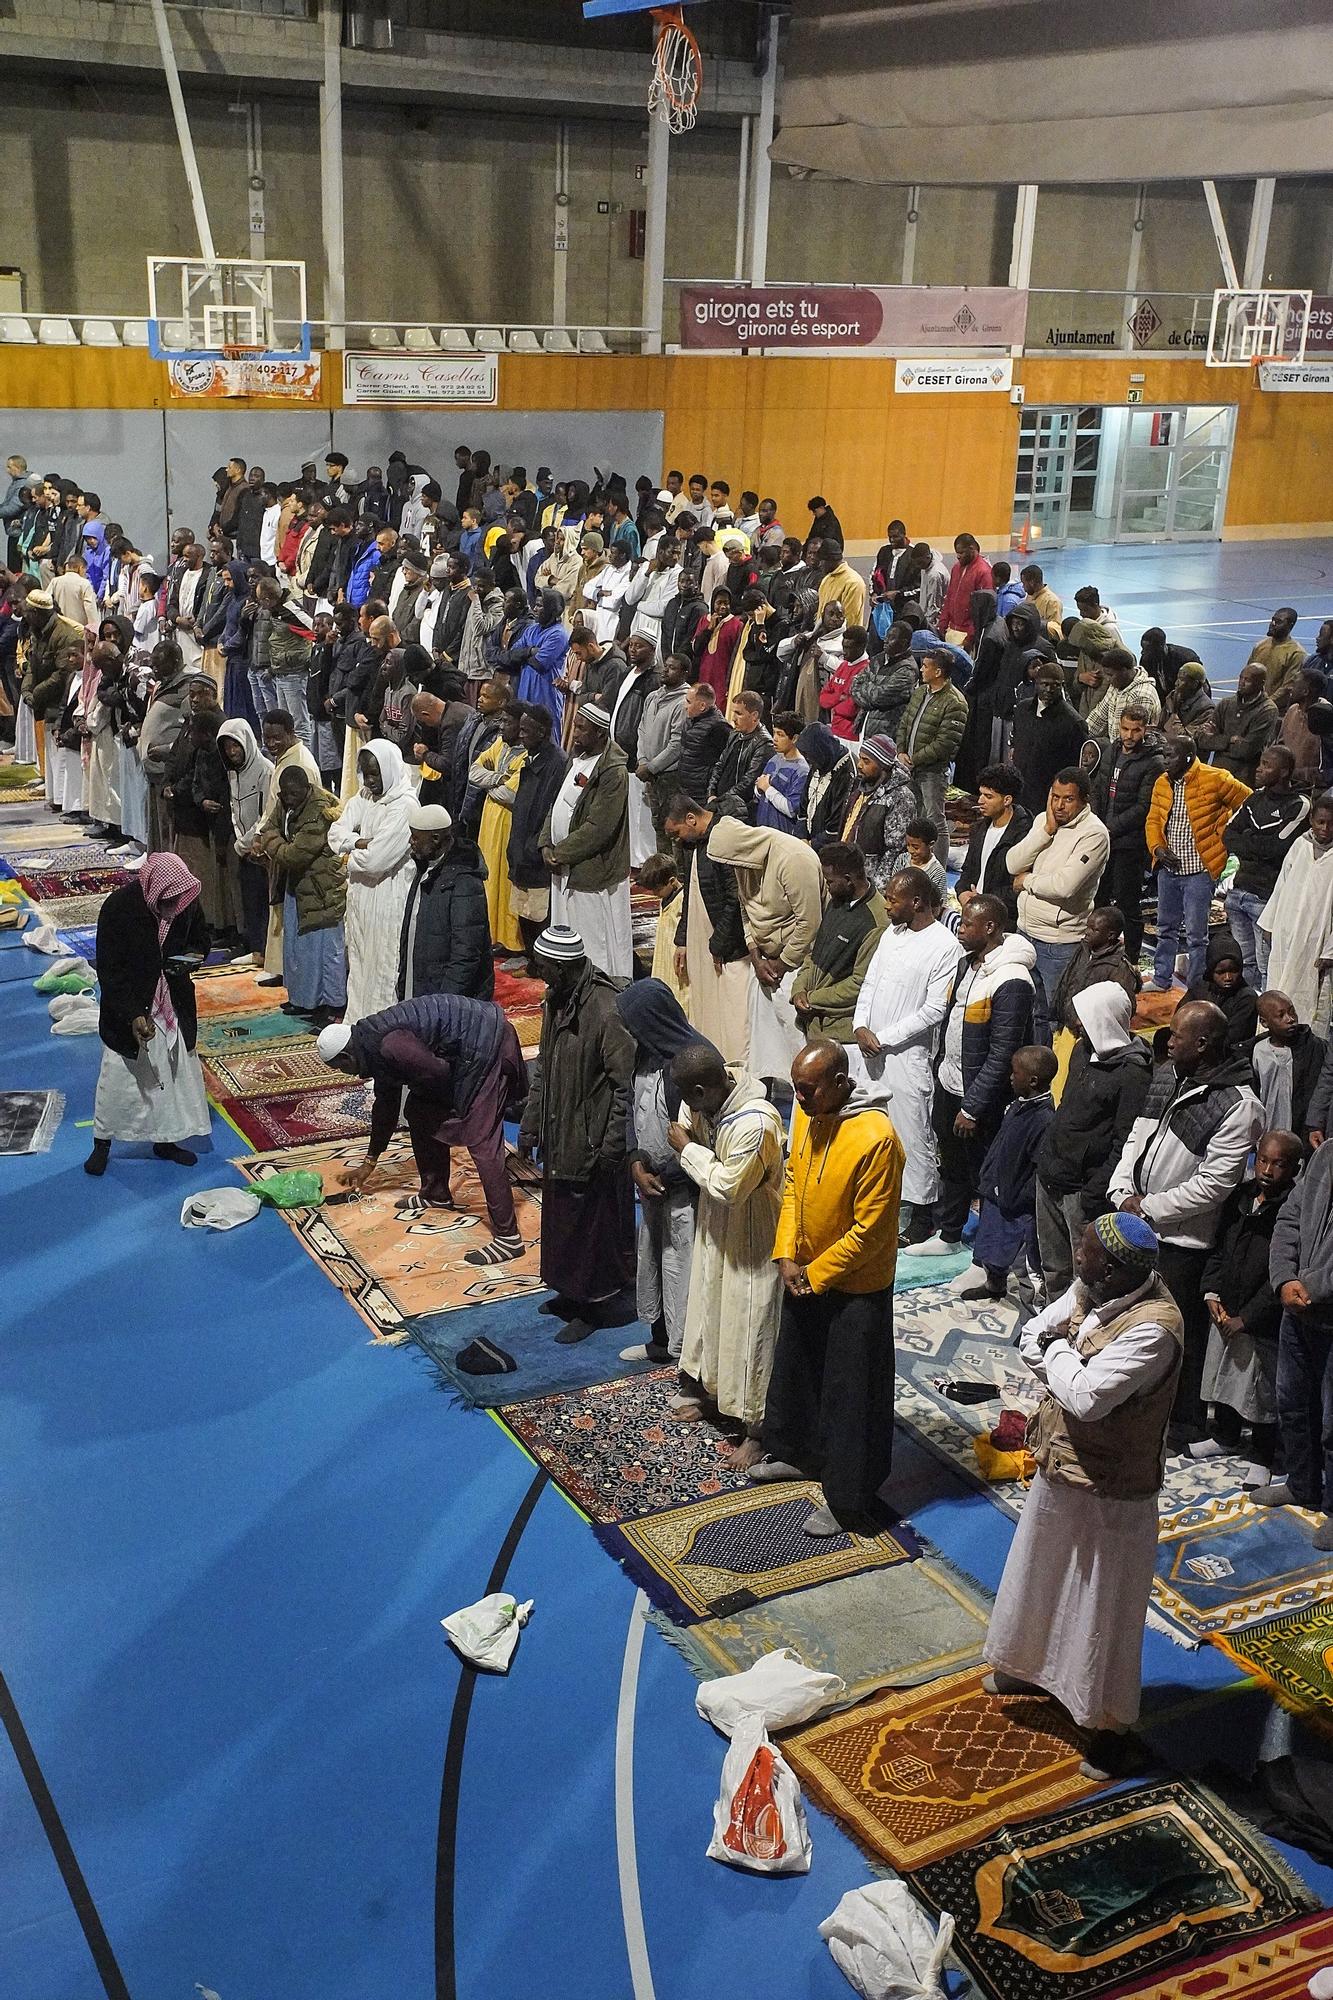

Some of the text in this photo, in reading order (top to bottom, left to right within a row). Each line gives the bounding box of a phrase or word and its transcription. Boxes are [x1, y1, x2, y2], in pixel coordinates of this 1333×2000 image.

[695, 298, 819, 325] girona ets tu
[737, 319, 860, 339] girona és esport
[1045, 328, 1116, 346] Ajuntament
[1167, 331, 1182, 345] de
[1285, 324, 1323, 341] girna
[256, 365, 276, 375] 402
[280, 365, 298, 377] 117
[356, 361, 486, 382] Carns Casellas
[1302, 373, 1331, 383] Girona
[917, 375, 988, 385] CESET Girona
